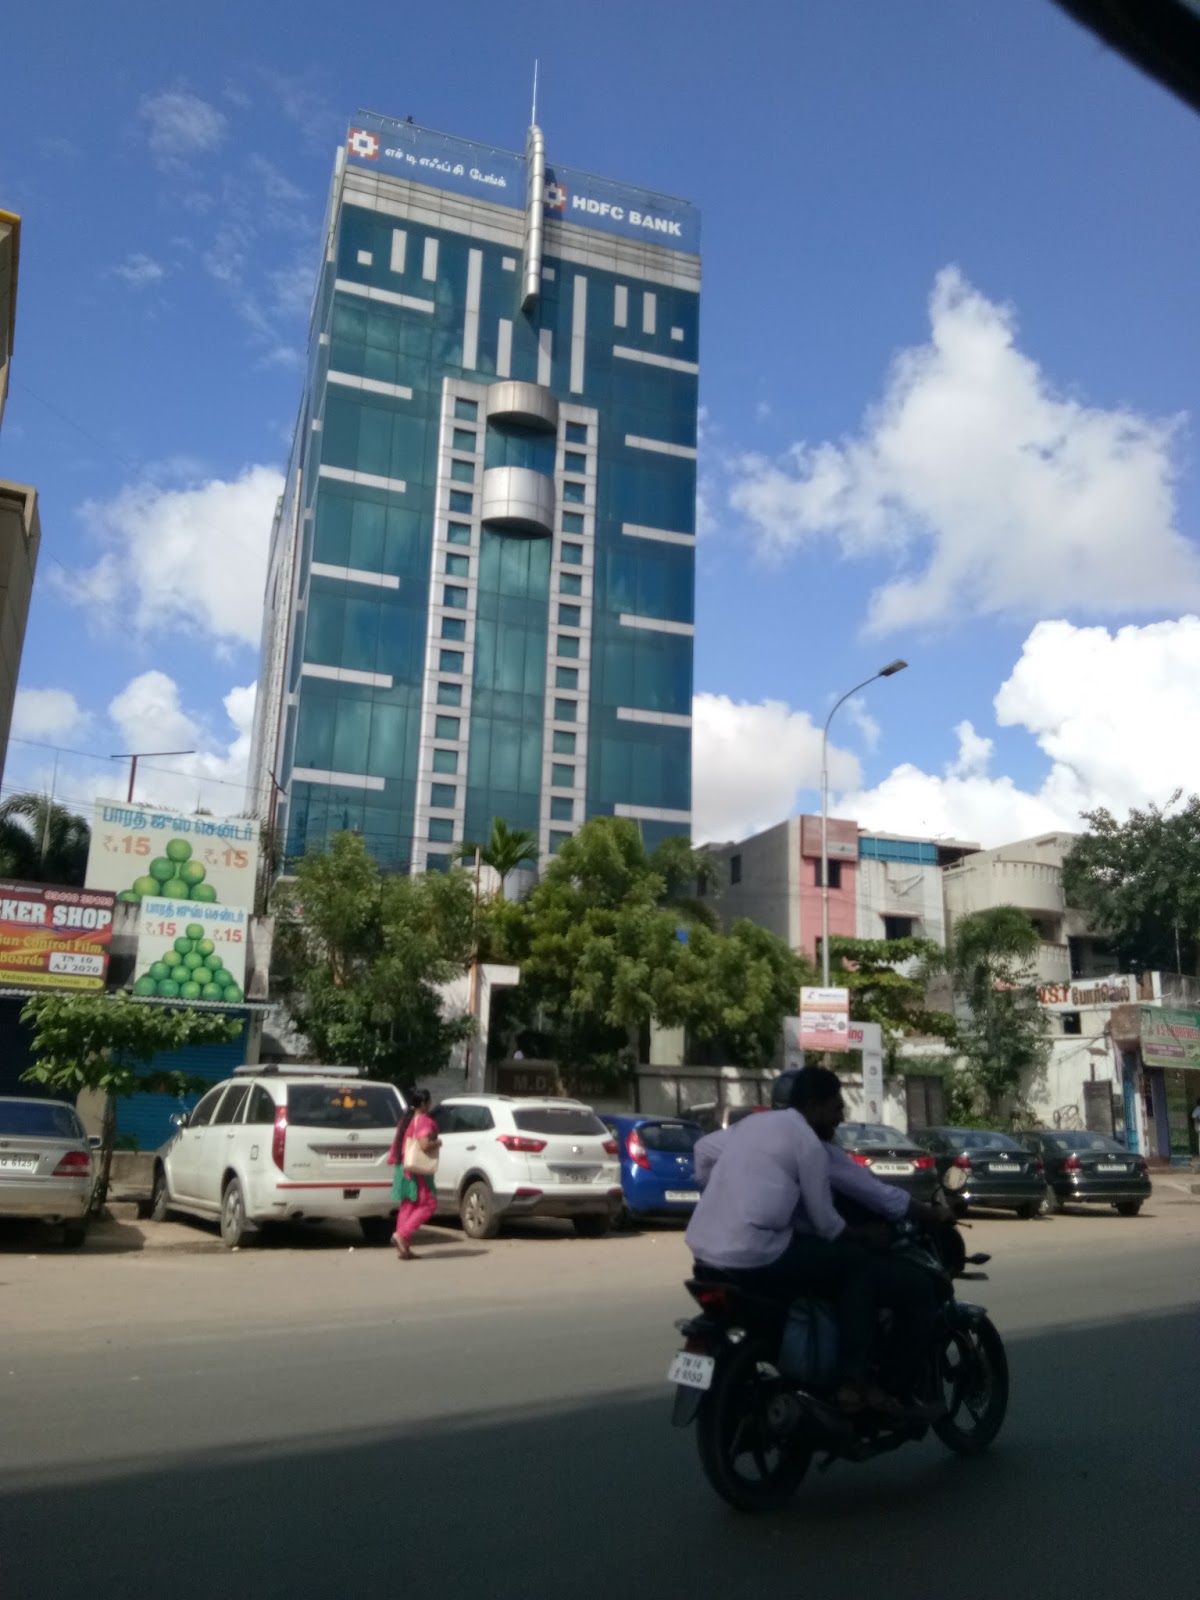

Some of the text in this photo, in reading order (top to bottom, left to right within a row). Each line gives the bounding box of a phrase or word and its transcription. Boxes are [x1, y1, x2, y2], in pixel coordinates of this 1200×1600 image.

[572, 195, 682, 237] HDFC BANK
[102, 806, 148, 830] பாரத்
[0, 899, 112, 930] KER SHOP
[0, 936, 19, 946] un
[23, 935, 72, 951] Control
[72, 964, 99, 973] 2070
